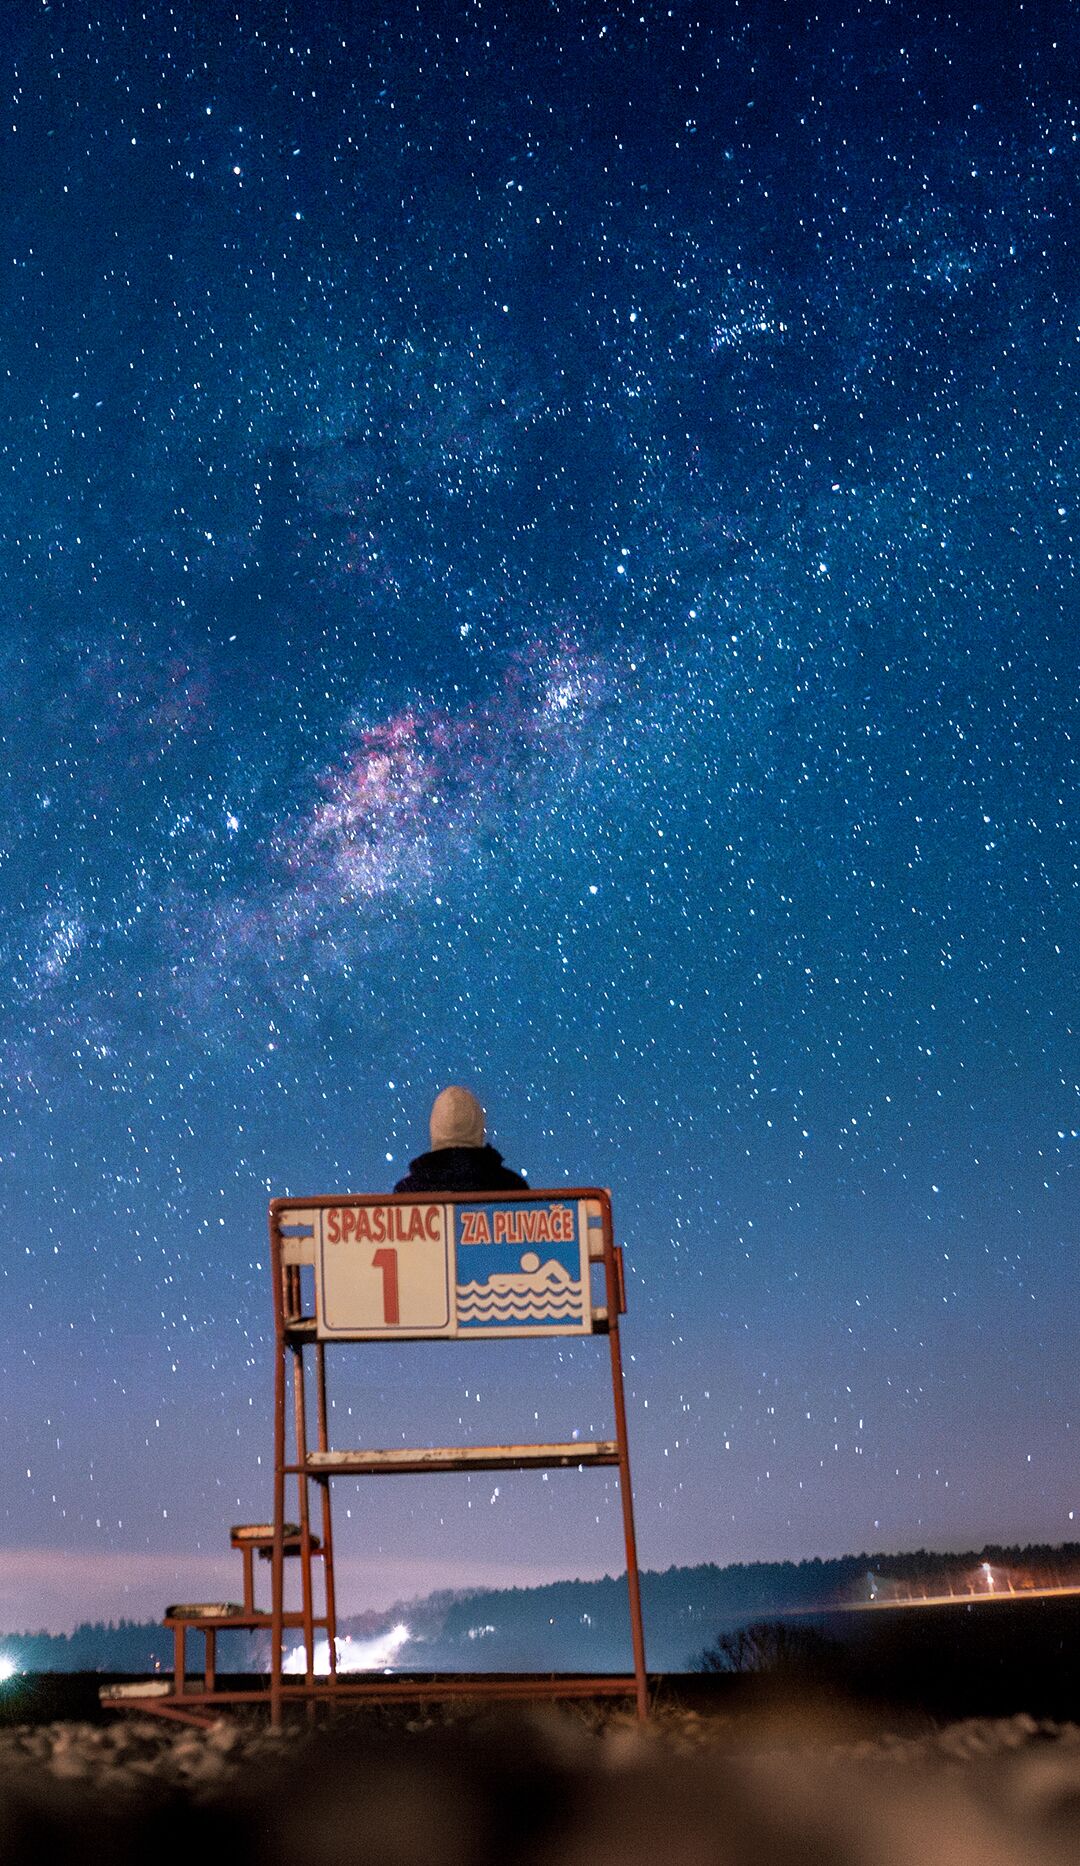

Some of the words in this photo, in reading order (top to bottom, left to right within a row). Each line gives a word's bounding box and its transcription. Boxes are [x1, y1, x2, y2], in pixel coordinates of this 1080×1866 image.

[327, 1205, 441, 1243] SPASILAC
[460, 1211, 490, 1244] ZA
[494, 1204, 575, 1243] PLIVAČE
[371, 1248, 400, 1325] 1
